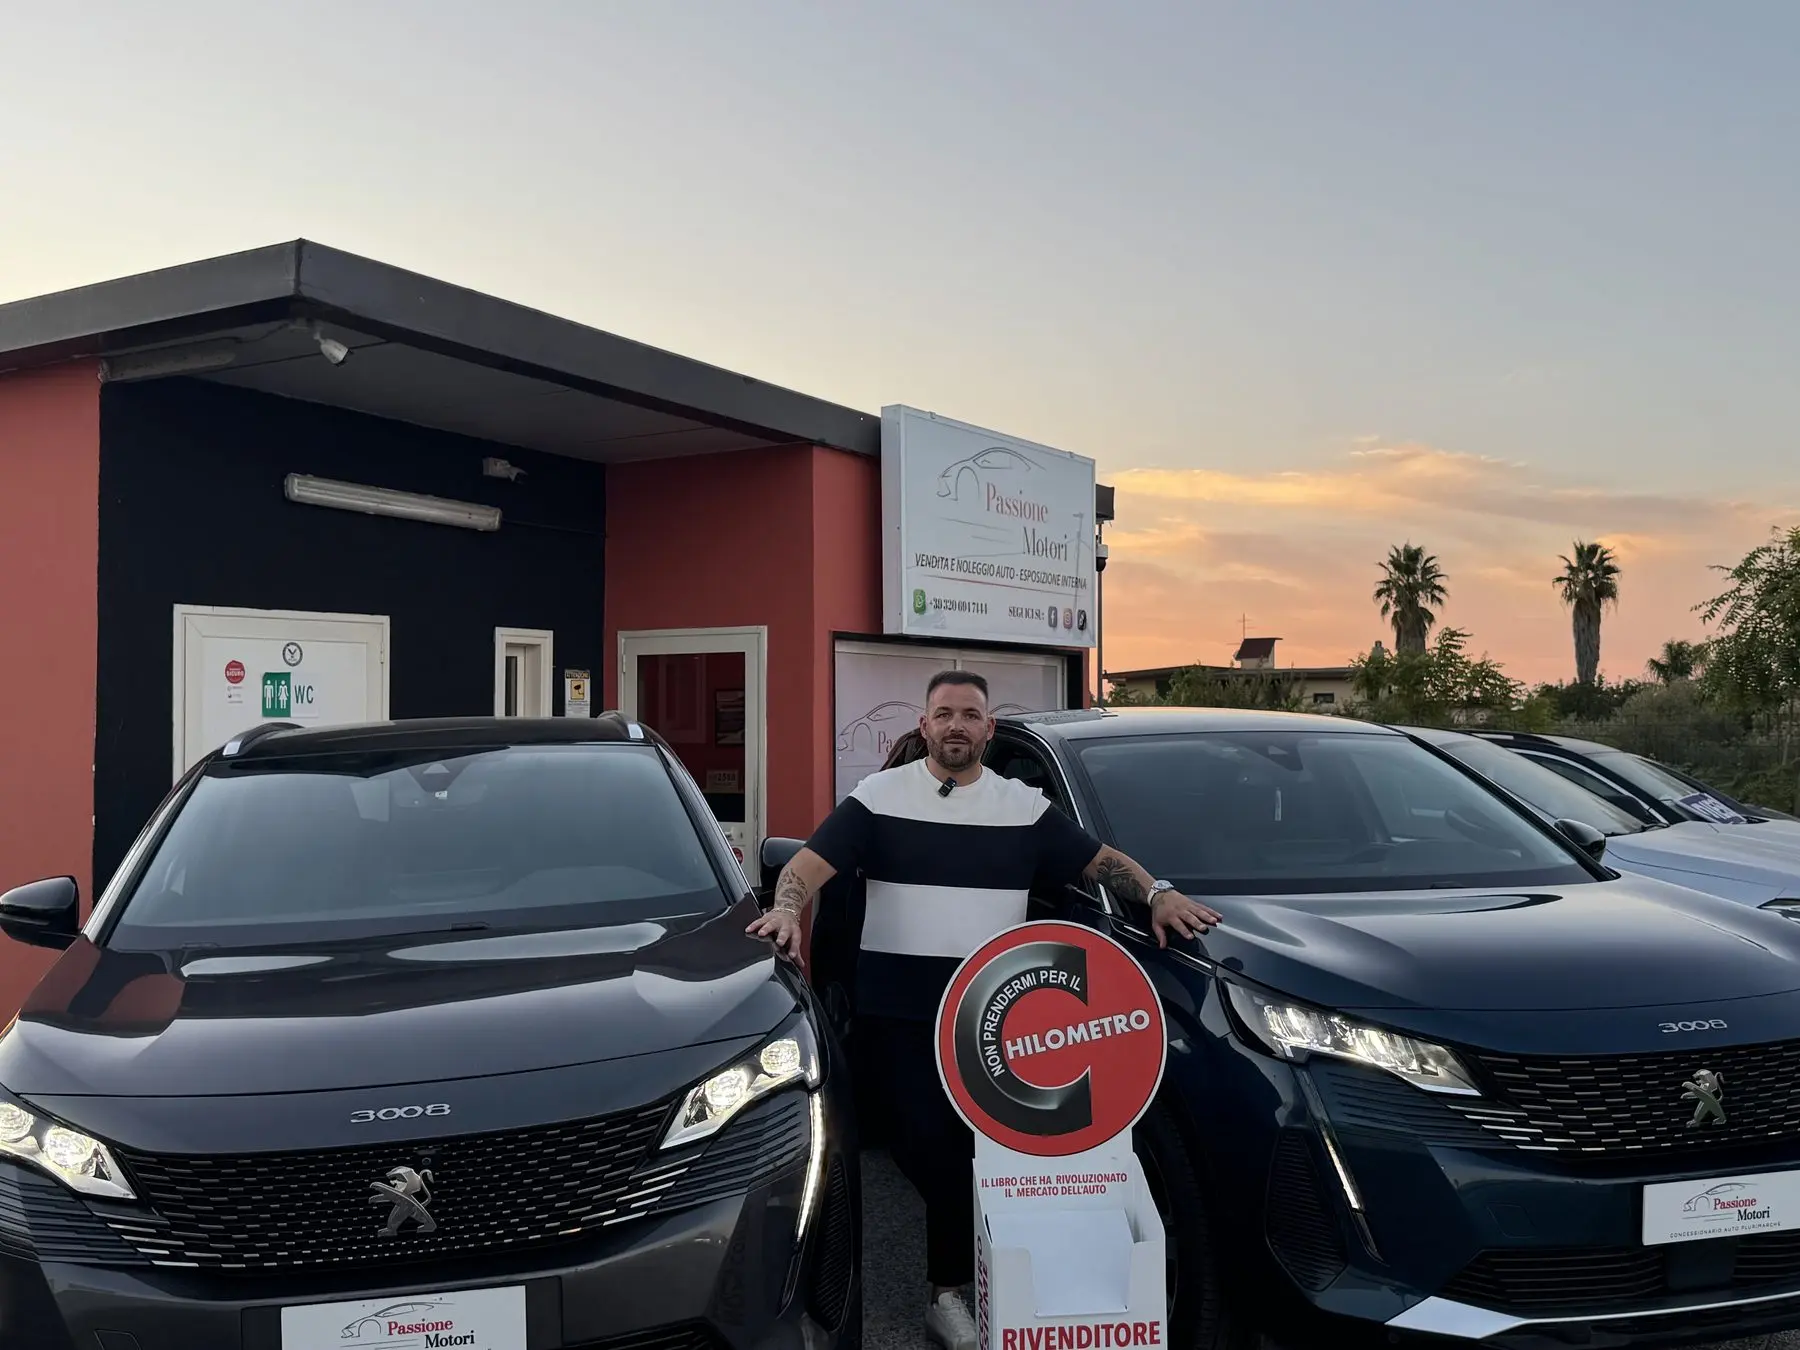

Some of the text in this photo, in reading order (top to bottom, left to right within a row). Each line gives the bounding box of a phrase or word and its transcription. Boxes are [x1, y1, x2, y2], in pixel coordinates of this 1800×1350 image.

[986, 482, 1049, 523] Passione
[1023, 527, 1068, 561] Motori
[915, 553, 950, 572] VENDITA
[951, 558, 956, 571] E
[956, 559, 995, 577] NOLEGGIO
[995, 566, 1015, 580] AUTO
[1019, 569, 1061, 586] ESPOSIZIONE
[1061, 574, 1087, 590] INTERNA
[294, 685, 314, 704] WC
[983, 970, 1081, 1077] NON PRENDERMI PER IL
[1658, 1019, 1727, 1033] 3008
[1004, 1009, 1150, 1060] HILOMETRO
[350, 1103, 451, 1123] 3008
[981, 1173, 1128, 1188] IL LIBRO CHE HA RIVOLUZIONATO
[1004, 1184, 1107, 1198] IL MERCATO DELL'AUTO
[1713, 1196, 1757, 1211] Passione
[1737, 1206, 1770, 1222] Motori
[1670, 1221, 1781, 1239] CONCESSIONARIO AUTO PLURIMARCHE
[387, 1318, 454, 1336] Passione
[1002, 1321, 1161, 1350] RIVENDITORE
[425, 1330, 475, 1349] Motori
